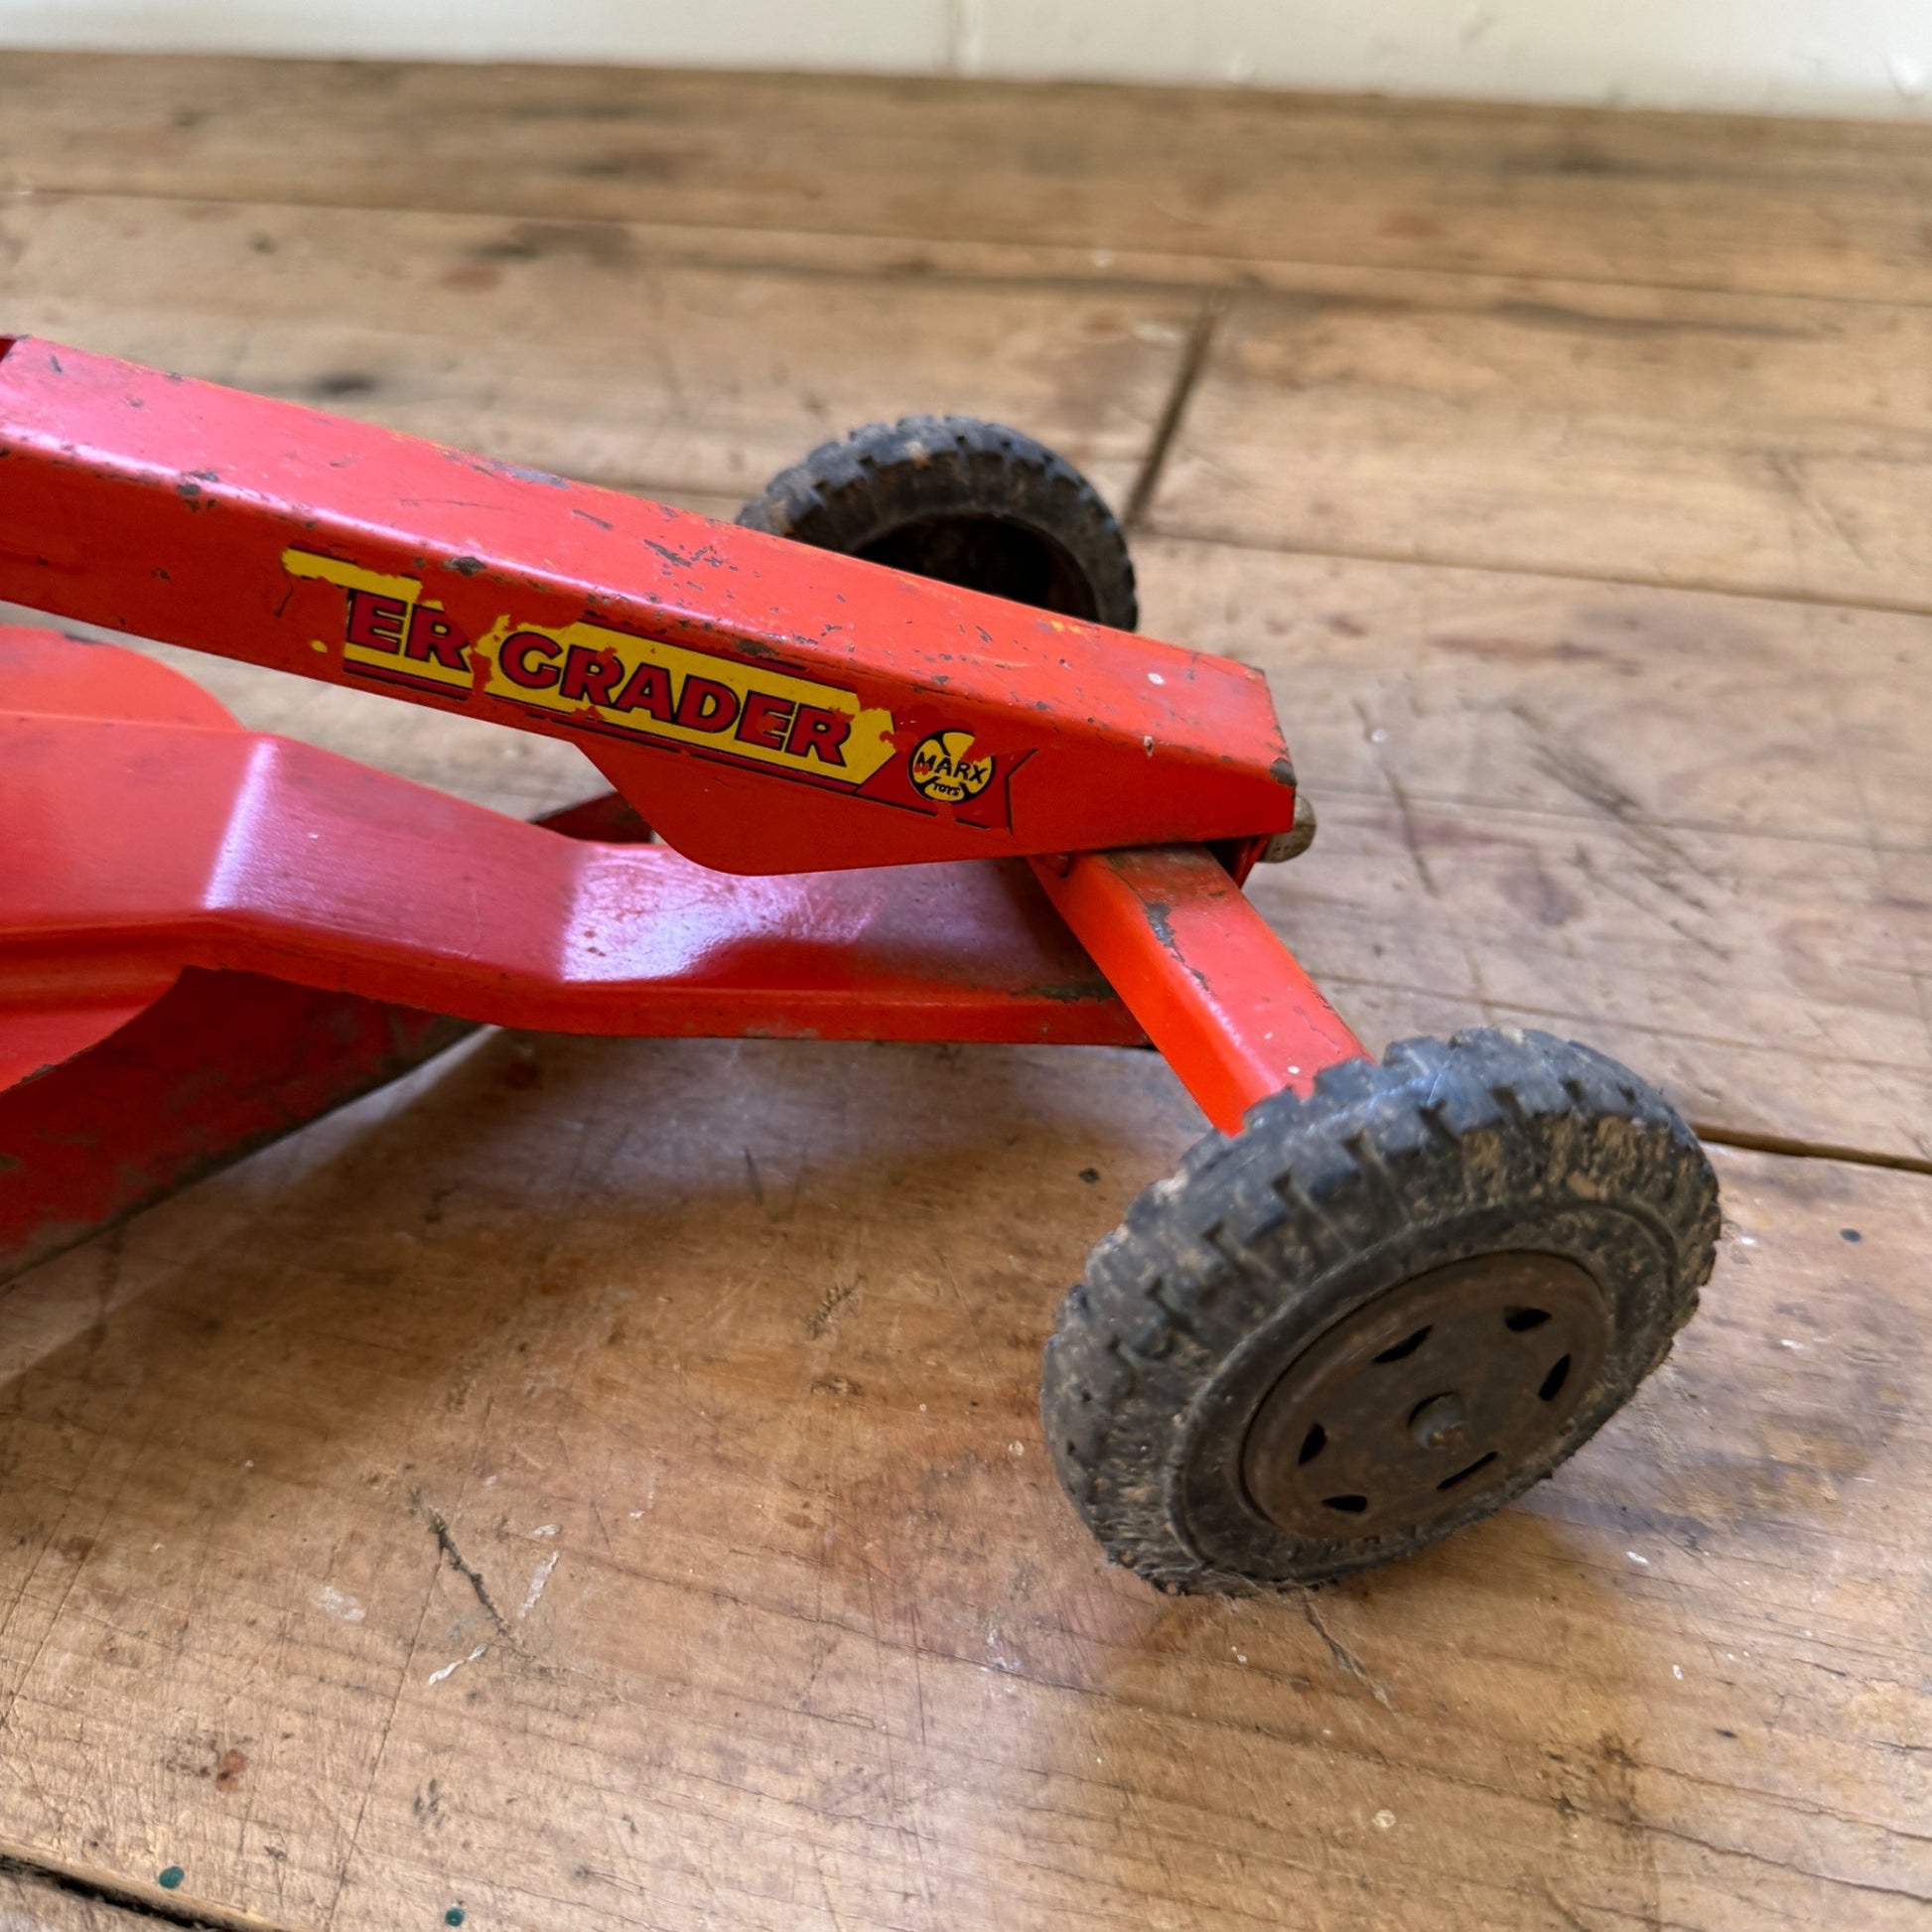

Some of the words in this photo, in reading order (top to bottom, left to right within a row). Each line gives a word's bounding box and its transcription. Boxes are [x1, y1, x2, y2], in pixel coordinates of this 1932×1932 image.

[499, 631, 851, 767] GRADER
[914, 752, 988, 784] MARX
[933, 781, 961, 796] TOYS
